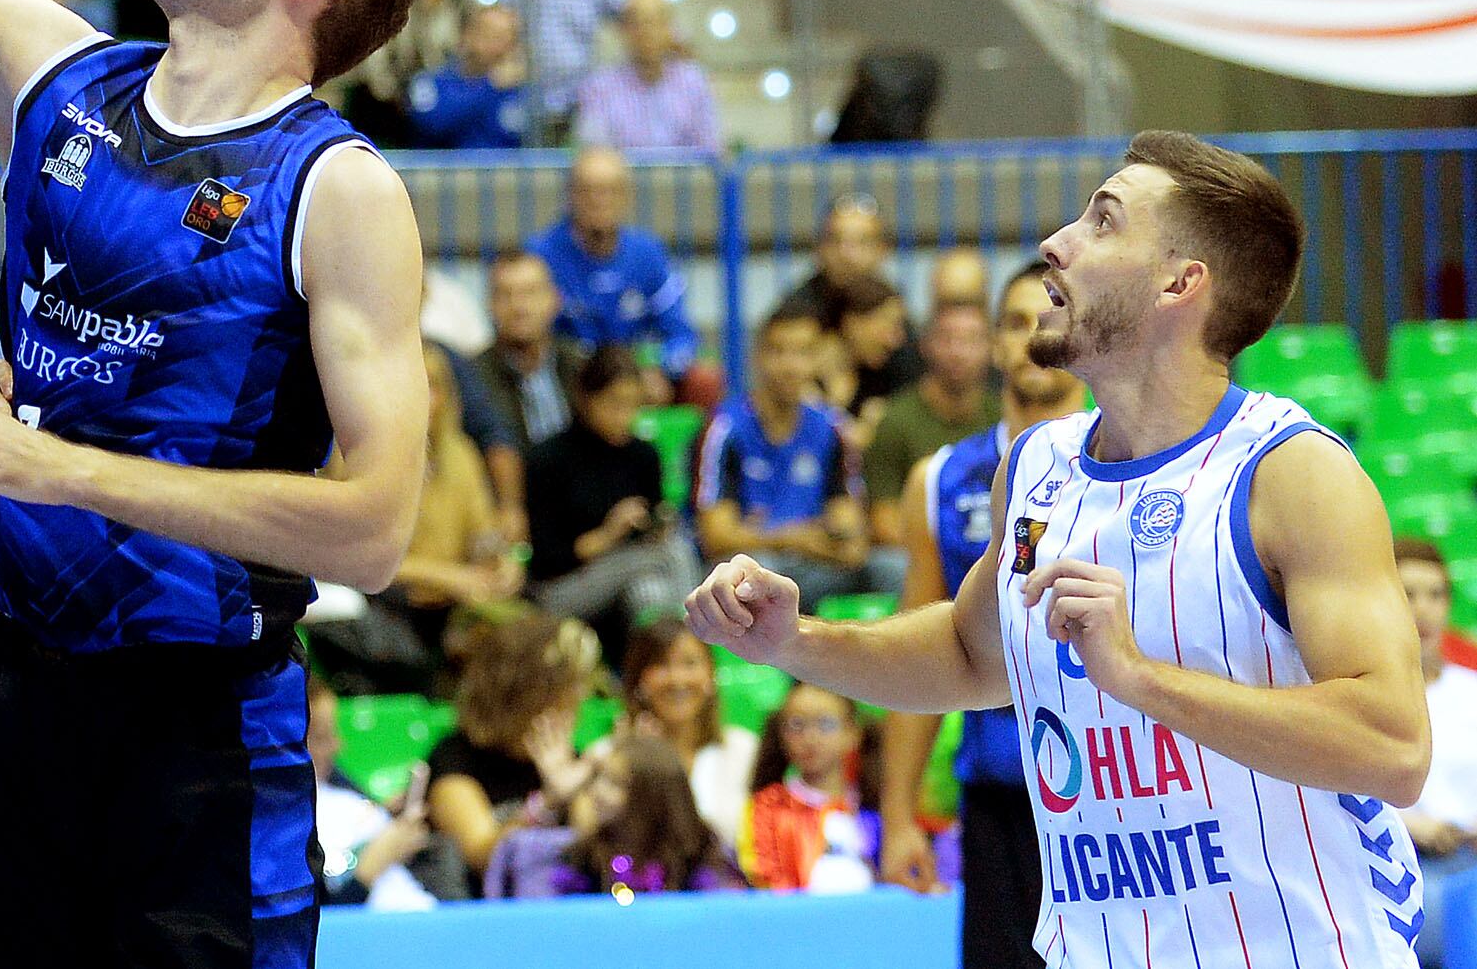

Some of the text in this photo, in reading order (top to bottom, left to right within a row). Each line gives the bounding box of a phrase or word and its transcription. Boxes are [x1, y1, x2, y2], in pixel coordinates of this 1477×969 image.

[46, 160, 86, 189] BURGOS
[200, 184, 221, 202] Liga
[186, 213, 212, 231] ORO
[1085, 723, 1193, 801] HLA
[1044, 819, 1232, 904] LICANTE
